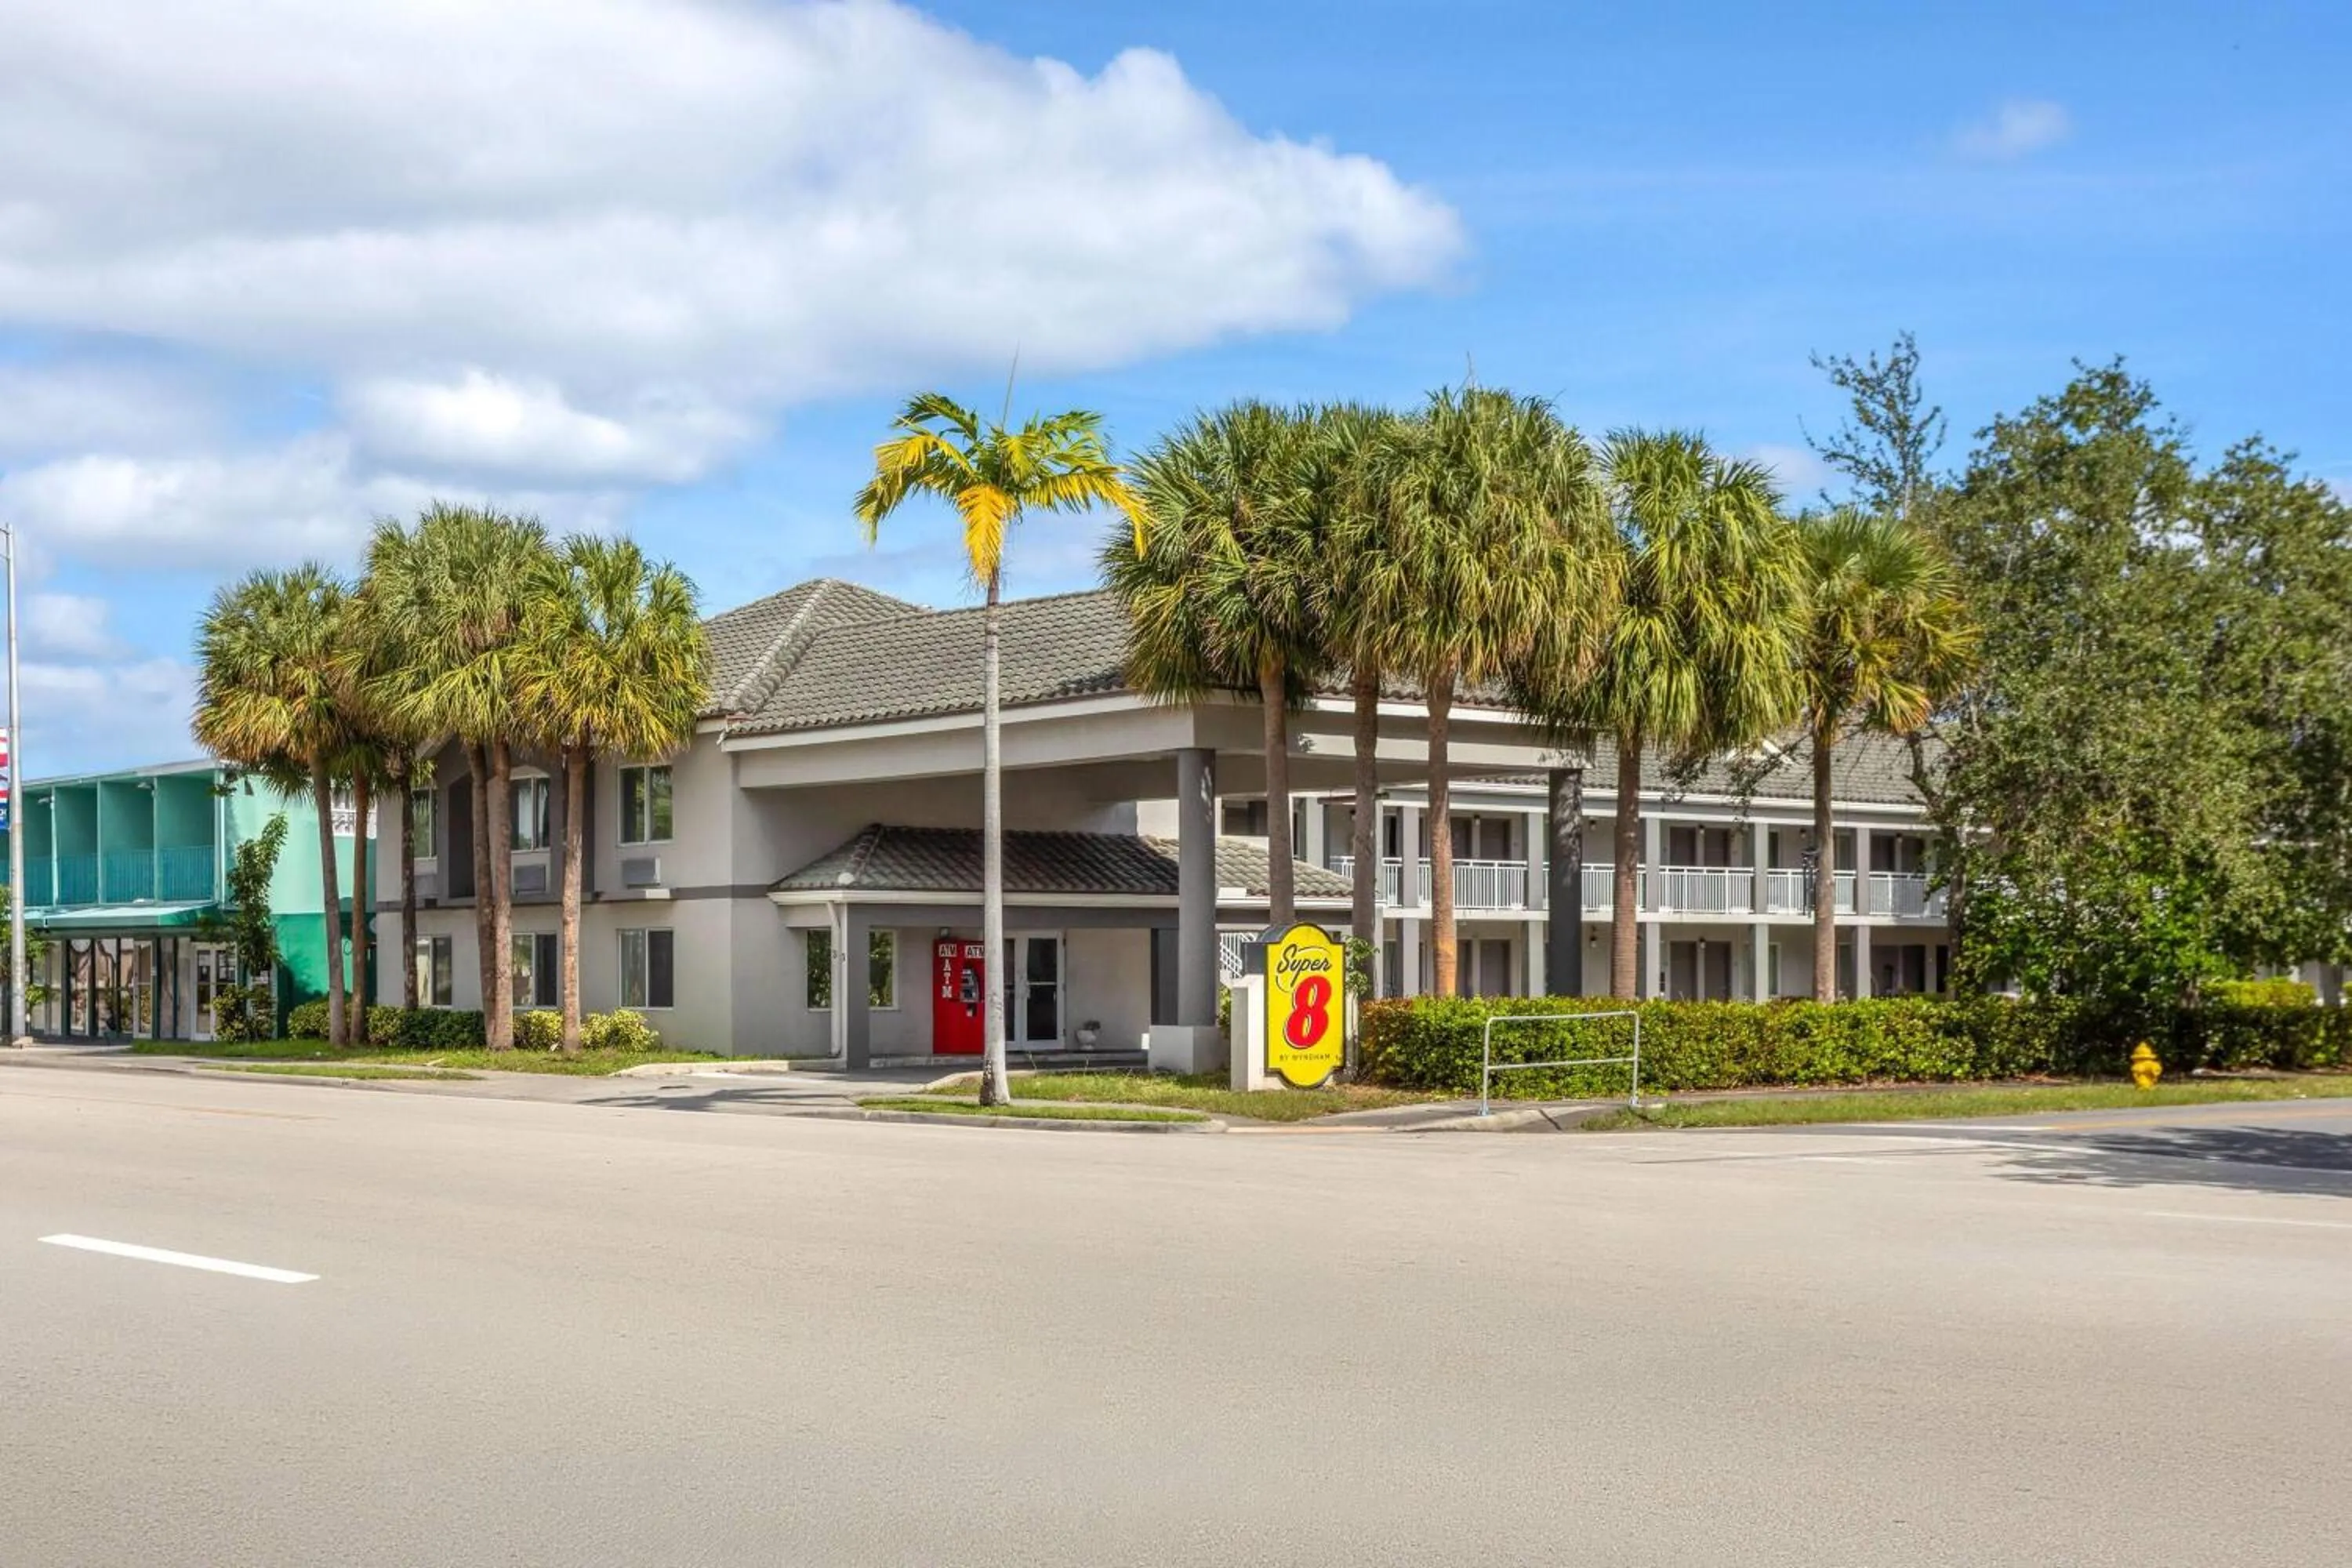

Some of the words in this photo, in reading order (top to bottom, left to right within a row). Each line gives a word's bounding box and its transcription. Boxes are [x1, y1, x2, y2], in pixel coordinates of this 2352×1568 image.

[941, 945, 956, 956] ATM
[1276, 943, 1333, 987] Super
[942, 958, 953, 998] ATM
[1282, 975, 1332, 1050] 8
